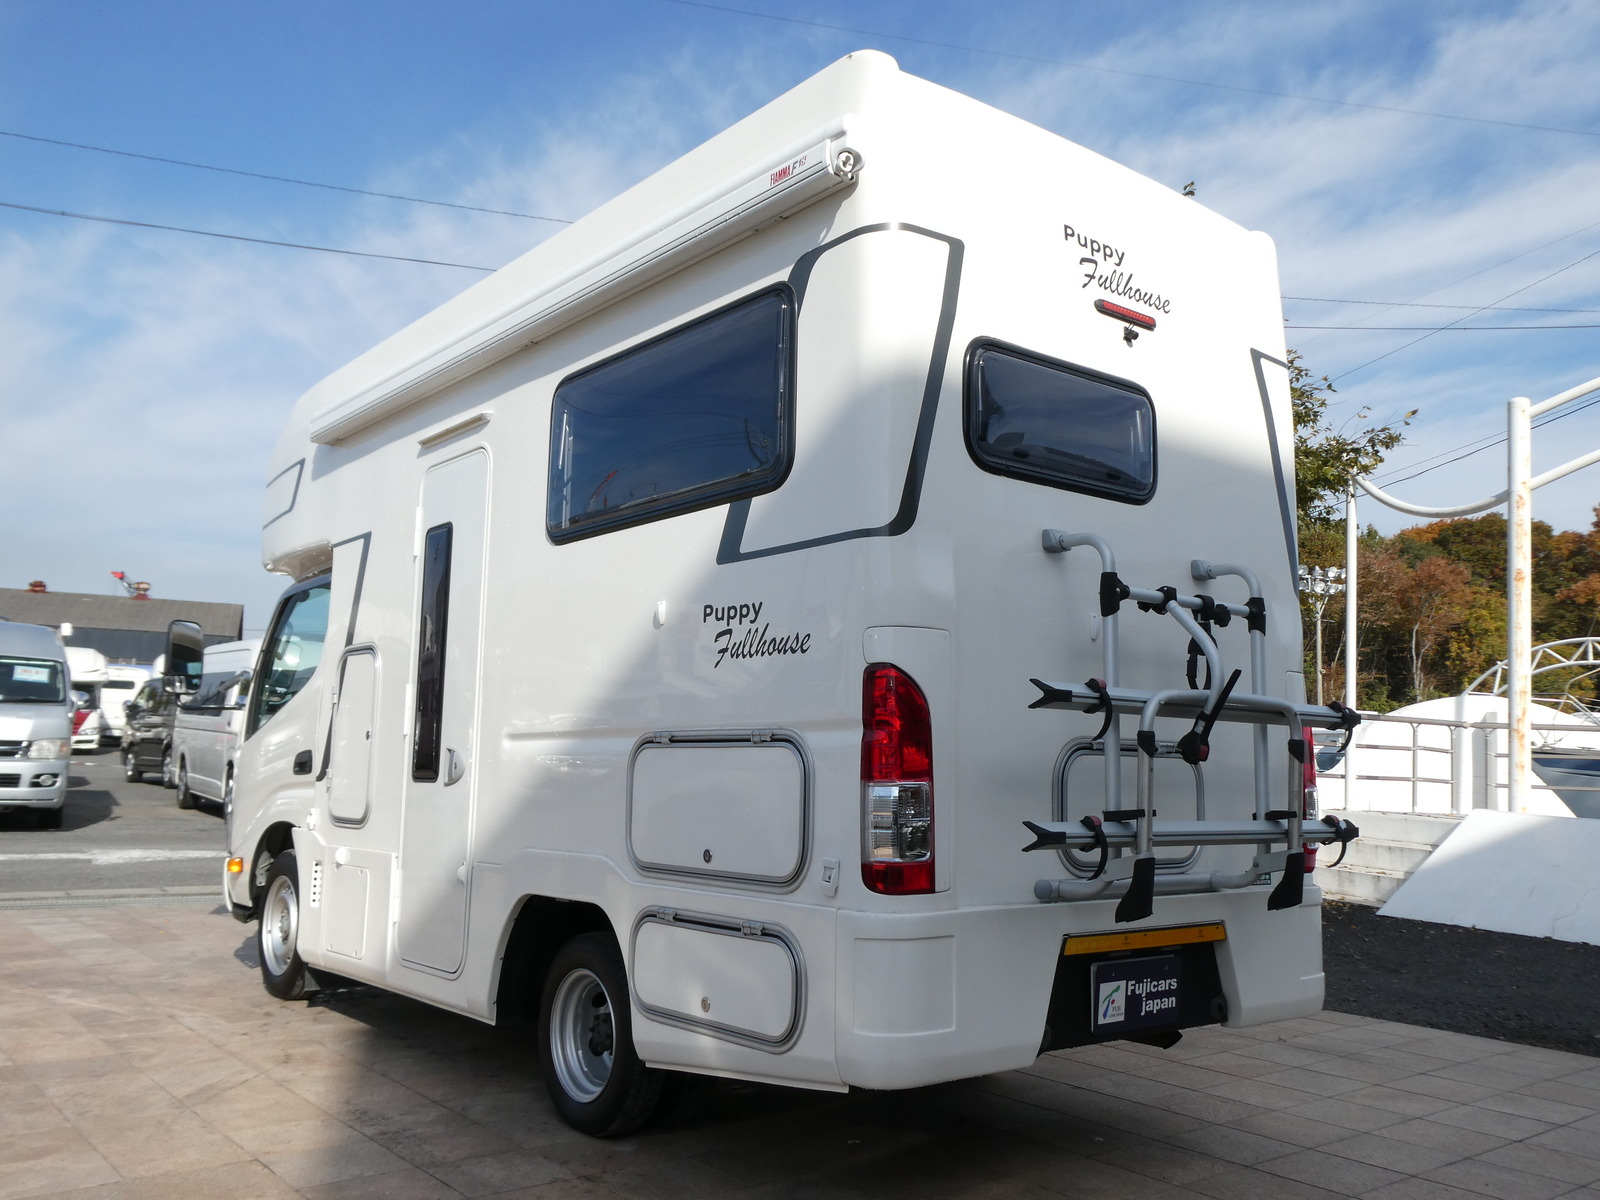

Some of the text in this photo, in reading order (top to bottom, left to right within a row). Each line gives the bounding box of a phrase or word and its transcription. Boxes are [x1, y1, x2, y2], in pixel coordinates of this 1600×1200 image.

[770, 165, 791, 186] FIAMMA
[1064, 224, 1125, 267] Puppy
[1079, 257, 1171, 314] Fullhouse
[703, 601, 763, 627] Puppy
[714, 622, 811, 669] Fullhouse
[1127, 978, 1178, 997] Fujicars
[1141, 996, 1176, 1016] japan
